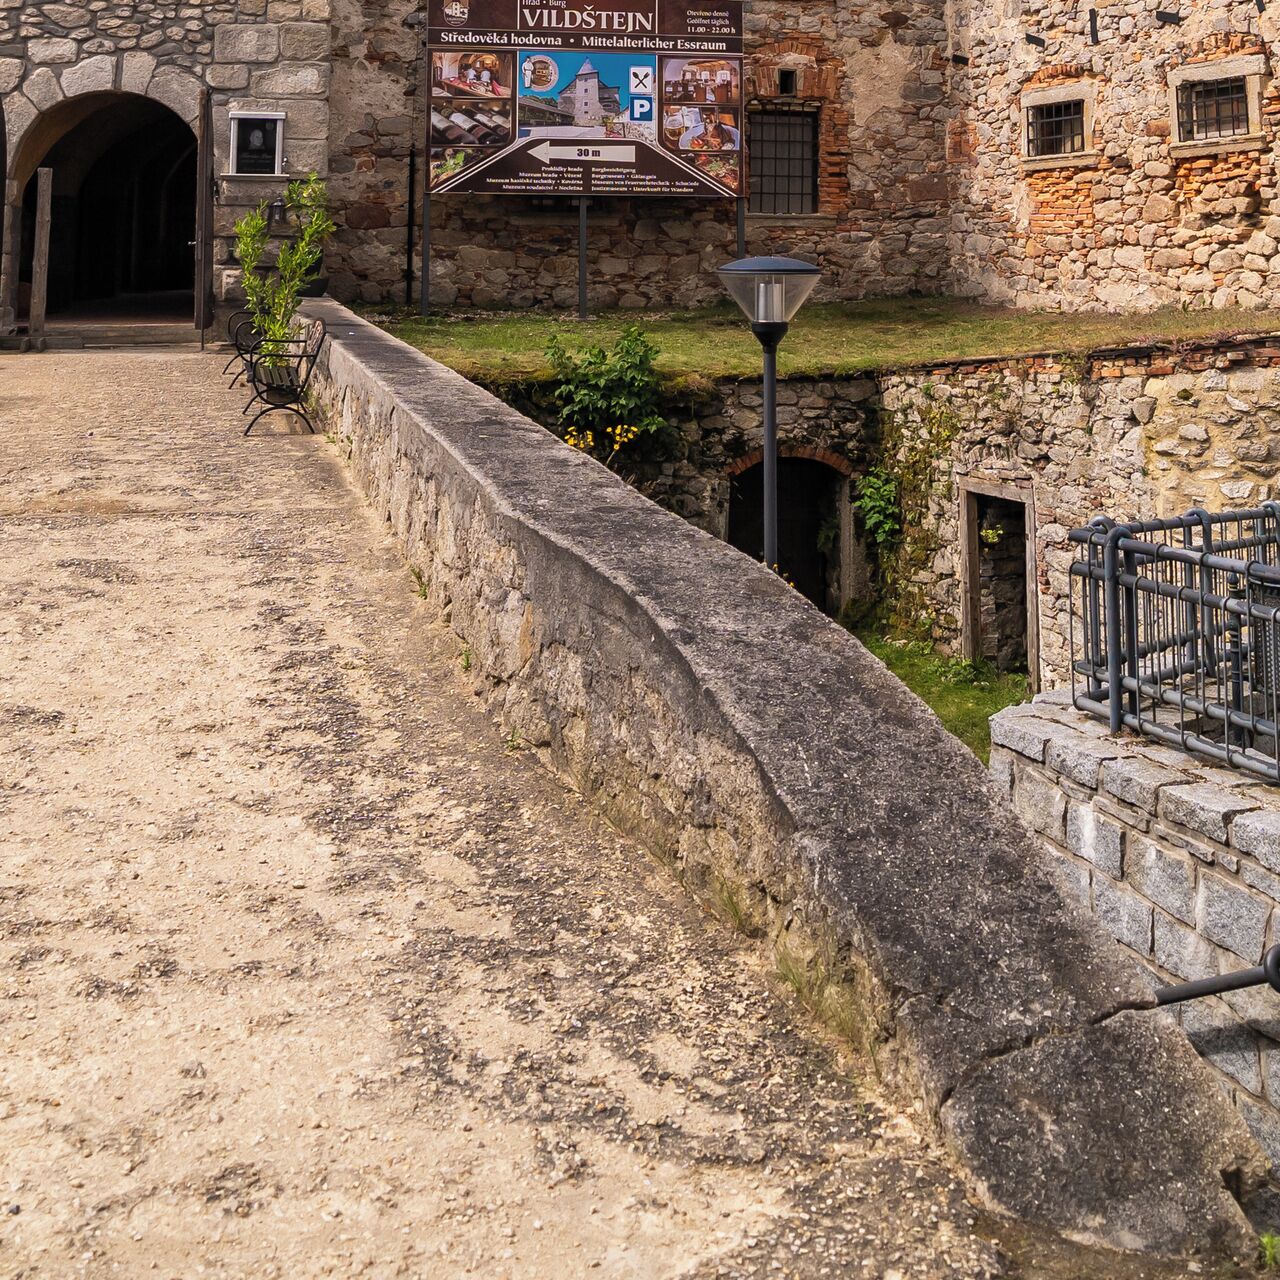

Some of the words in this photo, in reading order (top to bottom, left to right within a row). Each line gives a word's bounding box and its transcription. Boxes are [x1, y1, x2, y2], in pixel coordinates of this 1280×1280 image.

[549, 0, 566, 8] Burg
[522, 4, 653, 33] VILDŠTEJN
[440, 31, 507, 44] Středověká
[511, 33, 562, 45] hodovna
[582, 36, 675, 49] Mittelalterlicher
[677, 39, 726, 50] Essraum
[633, 99, 650, 118] P
[577, 148, 589, 157] 30
[591, 149, 600, 157] m
